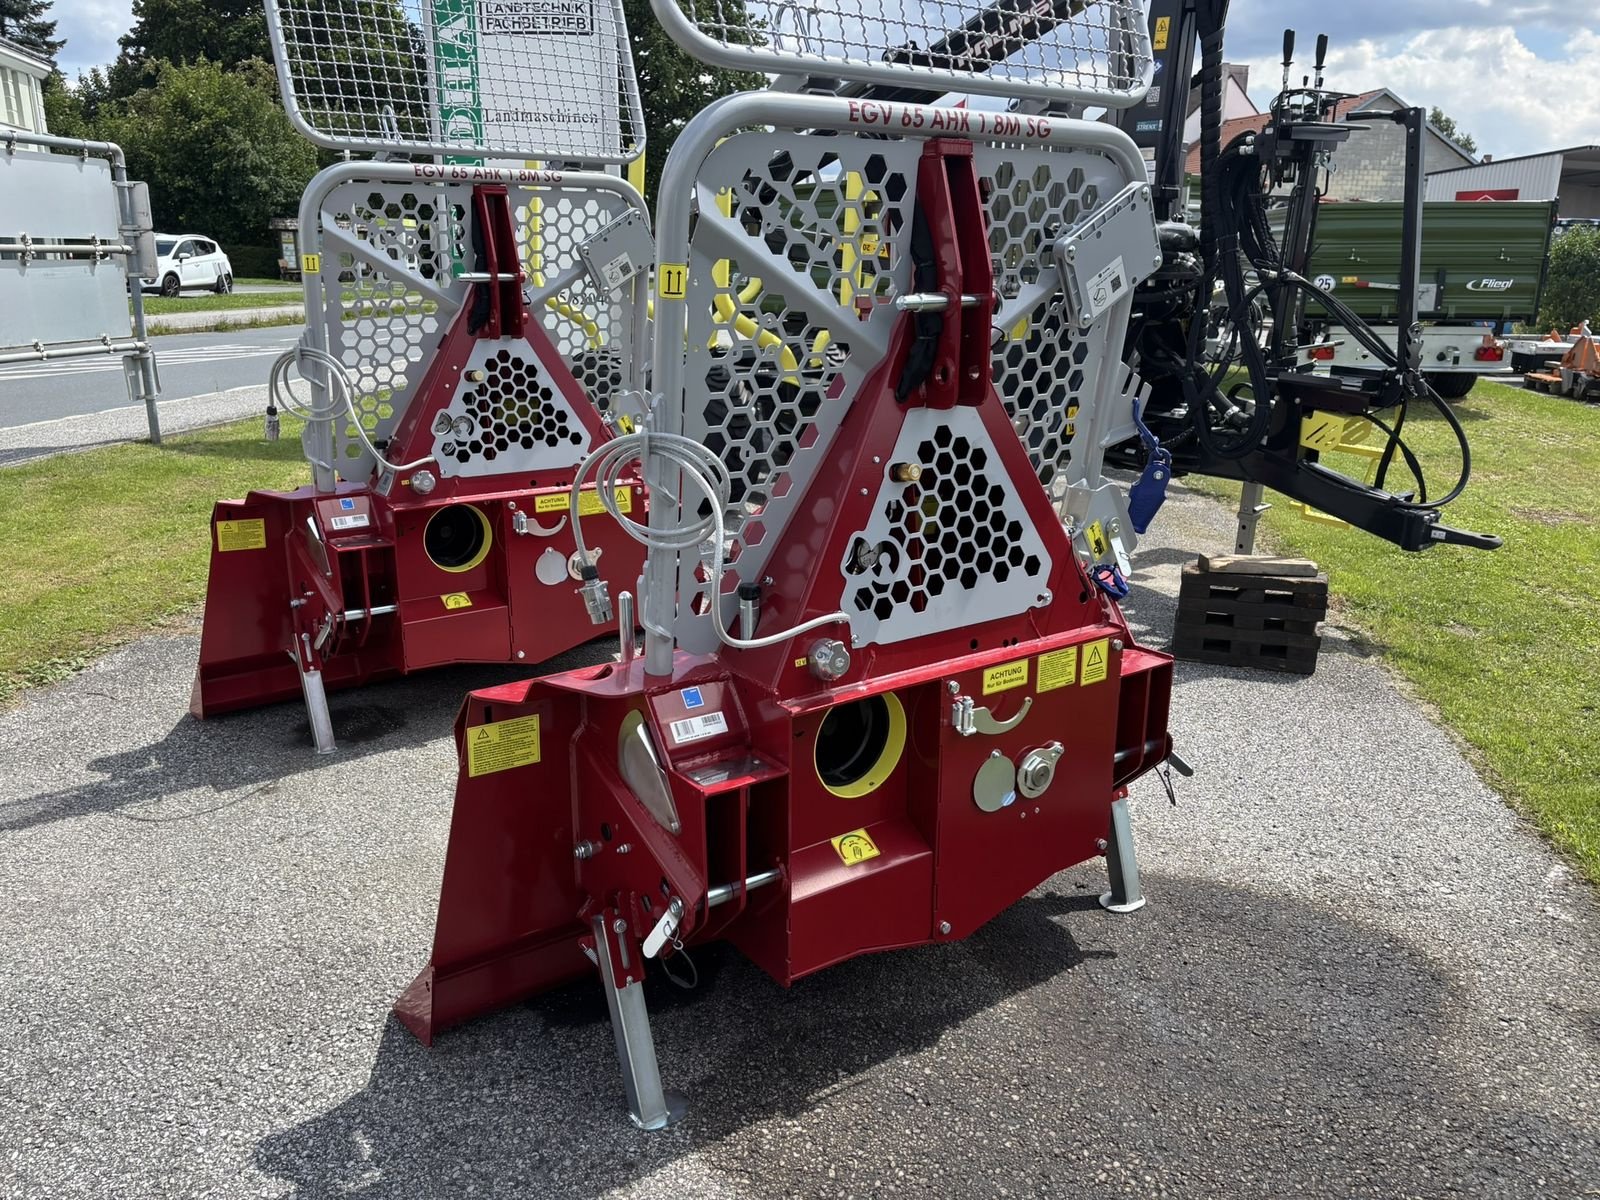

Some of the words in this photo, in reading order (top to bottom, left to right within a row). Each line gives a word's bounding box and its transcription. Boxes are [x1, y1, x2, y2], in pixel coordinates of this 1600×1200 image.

[484, 107, 599, 124] Landmaschinen
[847, 100, 893, 125] EGV
[901, 106, 925, 128] 65
[930, 109, 970, 132] AHK
[979, 113, 1021, 137] 1.8M
[1026, 117, 1051, 138] SG
[414, 164, 445, 178] EGV
[451, 167, 468, 179] 65
[472, 168, 502, 180] AHK
[508, 169, 540, 182] 1.8M
[543, 170, 562, 182] SG
[1317, 277, 1331, 291] 25
[1480, 278, 1514, 290] Fliegl
[990, 666, 1022, 681] ACHTUNG
